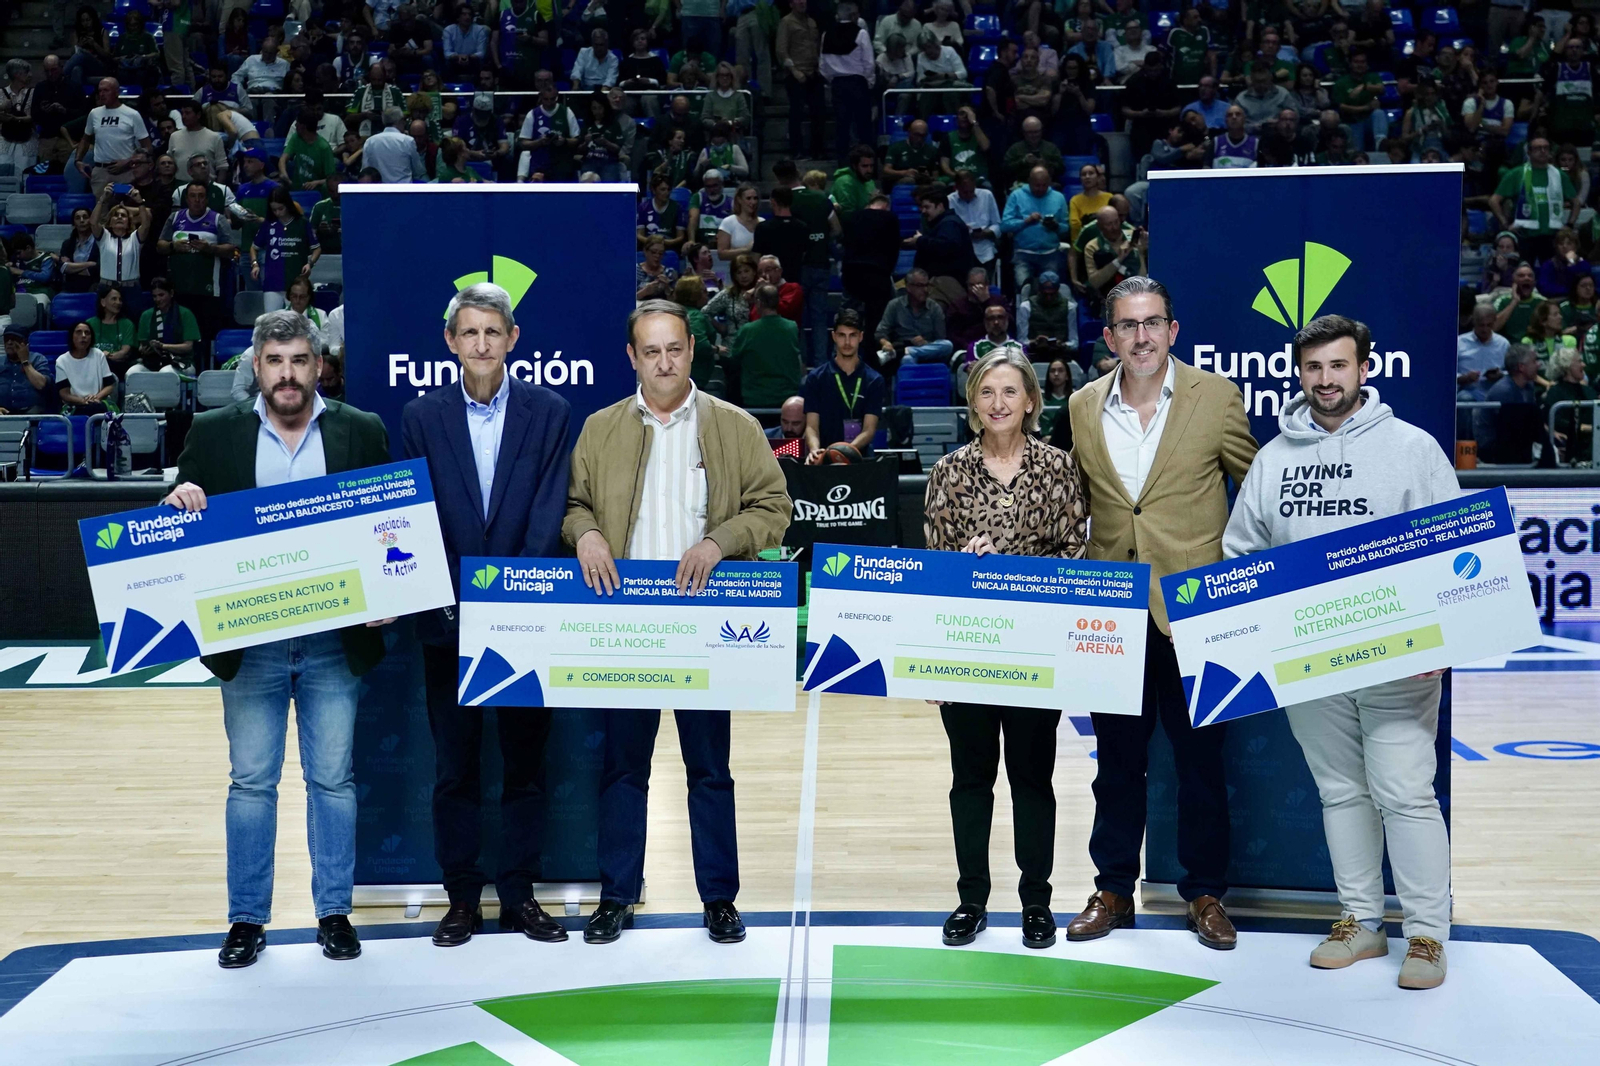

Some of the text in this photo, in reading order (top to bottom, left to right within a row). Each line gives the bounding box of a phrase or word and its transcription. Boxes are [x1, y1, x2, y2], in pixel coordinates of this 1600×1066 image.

[101, 116, 119, 125] HH
[389, 351, 594, 386] Función
[1193, 341, 1411, 378] Fundón
[337, 469, 413, 489] 17 de marzo de 2024
[1282, 463, 1353, 482] LIVING
[255, 502, 286, 515] Partido
[287, 495, 325, 508] dedicado
[332, 491, 341, 500] la
[341, 484, 384, 498] Fundación
[384, 478, 415, 492] Unicaja
[1280, 482, 1323, 499] FOR
[256, 488, 417, 525] UNICAJA BALONCESTO REAL MADRID
[794, 497, 886, 521] SPALDING
[1279, 498, 1374, 518] OTHERS.
[1410, 500, 1491, 528] 17 de marzo de 2024
[127, 510, 202, 533] Fundación
[373, 516, 411, 535] Asociación
[130, 526, 185, 545] Unicaja
[1326, 510, 1494, 560] Partido dedicado a la Fundación Unicaja
[1328, 520, 1496, 571] UNICAJA BALONCESTO REAL MADRID
[236, 549, 309, 574] EN ACTIVO
[383, 561, 417, 577] En Activo
[854, 555, 923, 570] Fundación
[126, 573, 186, 591] A BENEFICIO DE:
[504, 567, 573, 580] Fundación
[853, 568, 903, 584] Unicaja
[973, 571, 1002, 580] Partido
[1004, 573, 1041, 582] dedicado
[1049, 575, 1056, 583] la
[1059, 576, 1101, 587] Fundación
[1102, 579, 1133, 589] Unicaja
[1103, 570, 1113, 578] de
[1114, 571, 1133, 579] 2024
[1204, 560, 1275, 588] Fundación
[504, 579, 554, 595] Unicaja
[623, 588, 660, 596] UNICAJA
[725, 589, 747, 597] REAL
[748, 590, 782, 598] MADRID
[624, 578, 653, 586] Partido
[709, 579, 750, 587] Fundación
[752, 580, 782, 589] Unicaja
[972, 581, 1132, 599] UNICAJA BALONCESTO REAL MADRID
[1207, 578, 1258, 599] Unicaja
[1437, 576, 1509, 600] COOPERACIÓN
[213, 579, 347, 614] # MAYORES EN ACTIVO #
[1294, 585, 1397, 621] COOPERACIÓN
[1438, 583, 1511, 607] INTERNACIONAL
[217, 597, 350, 631] # MAYORES CREATIVOS #
[844, 613, 881, 621] BENEFICIO
[935, 614, 1014, 629] FUNDACIÓN
[1294, 600, 1406, 638] INTERNACIONAL
[560, 620, 697, 634] ÁNGELES MALAGUEÑOS
[1211, 627, 1249, 643] BENEFICIO
[1249, 624, 1261, 633] DE:
[590, 638, 666, 649] DE LA NOCHE
[946, 631, 1001, 644] HARENA
[1068, 632, 1123, 643] Fundación
[1304, 638, 1414, 673] # SÉ MÁS TÚ #
[567, 673, 692, 684] # COMEDOR SOCIAL #
[909, 665, 1038, 681] # LA MAYOR CONEXIÓN #
